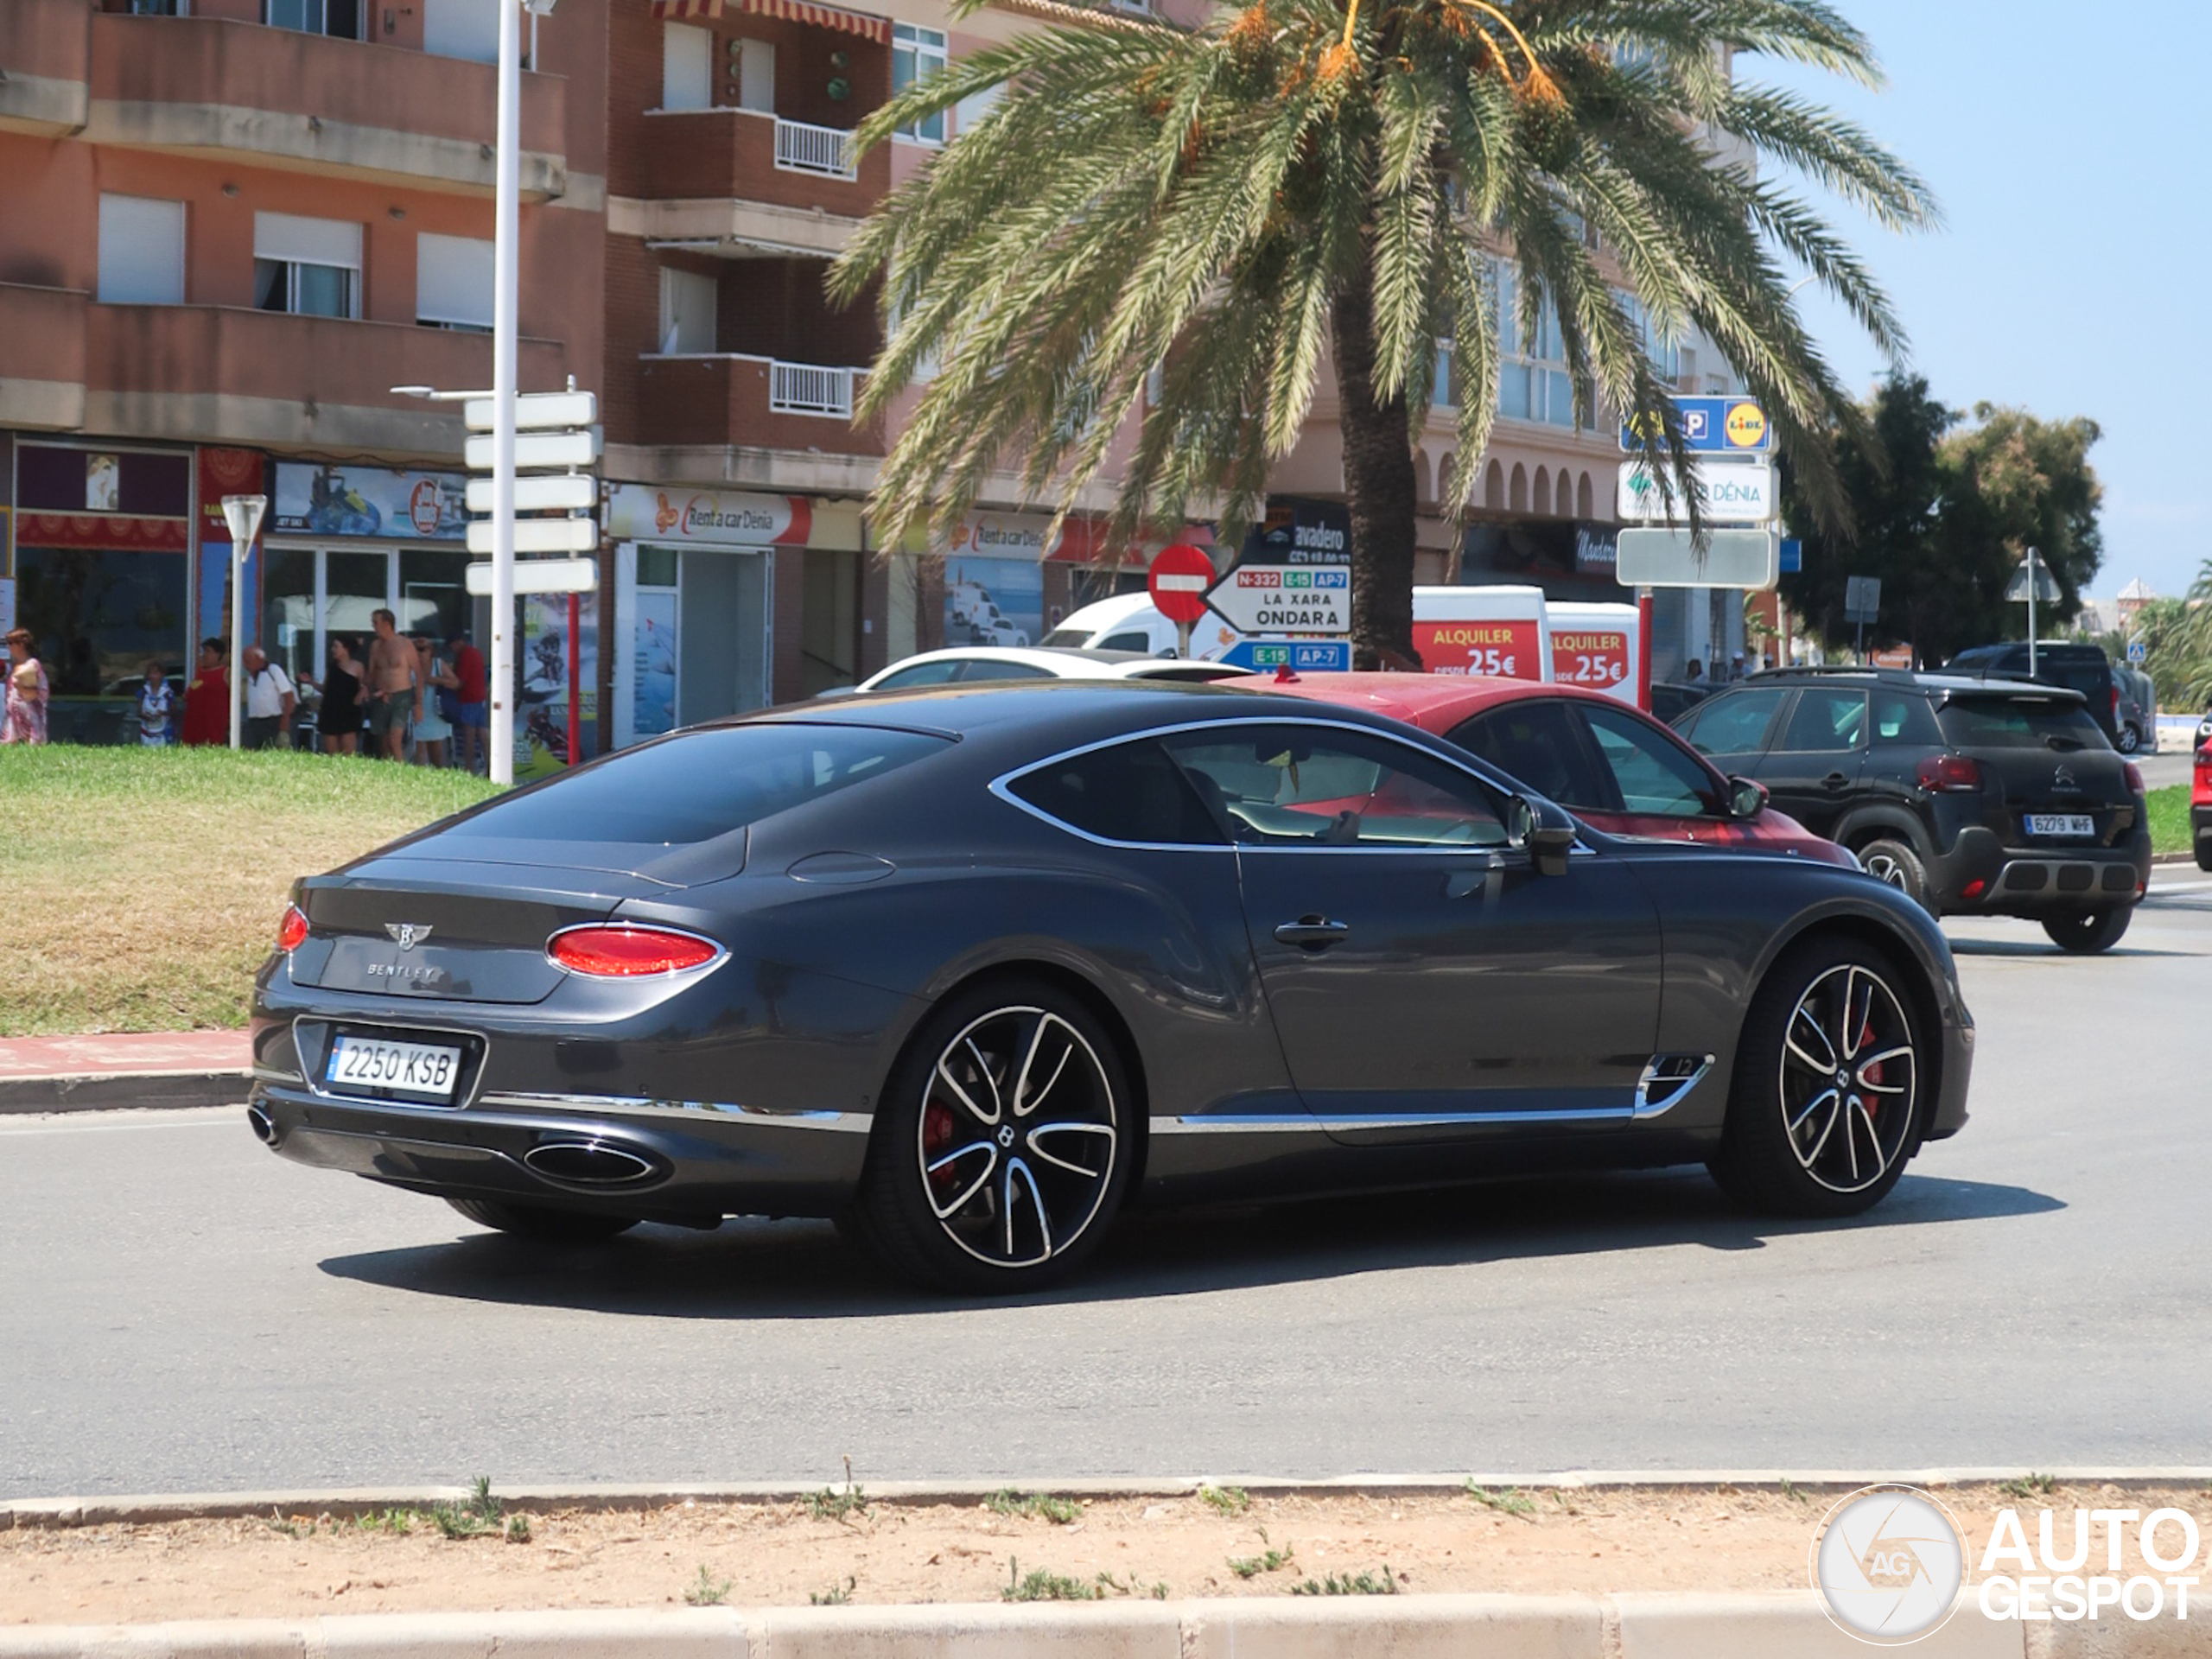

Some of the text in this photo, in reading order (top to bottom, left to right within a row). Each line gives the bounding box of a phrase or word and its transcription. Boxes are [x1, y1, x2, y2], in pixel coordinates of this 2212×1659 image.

[1713, 480, 1761, 502] DÉNIA
[689, 507, 715, 526] Rent
[716, 513, 724, 528] a
[725, 512, 743, 529] car
[978, 525, 1000, 544] Rent
[1007, 531, 1023, 546] car
[1239, 573, 1345, 586] N-332 E-15 AP-7
[1264, 594, 1332, 606] LA XARA
[1256, 610, 1338, 626] ONDARA
[1433, 628, 1513, 646] ALQUILER
[1256, 650, 1336, 663] E-15 AP-7
[1467, 648, 1516, 676] 25€
[1574, 654, 1623, 681] 25€
[2035, 817, 2066, 831] 6279
[367, 963, 434, 979] BENTLEY
[344, 1045, 452, 1087] 2250 KSB
